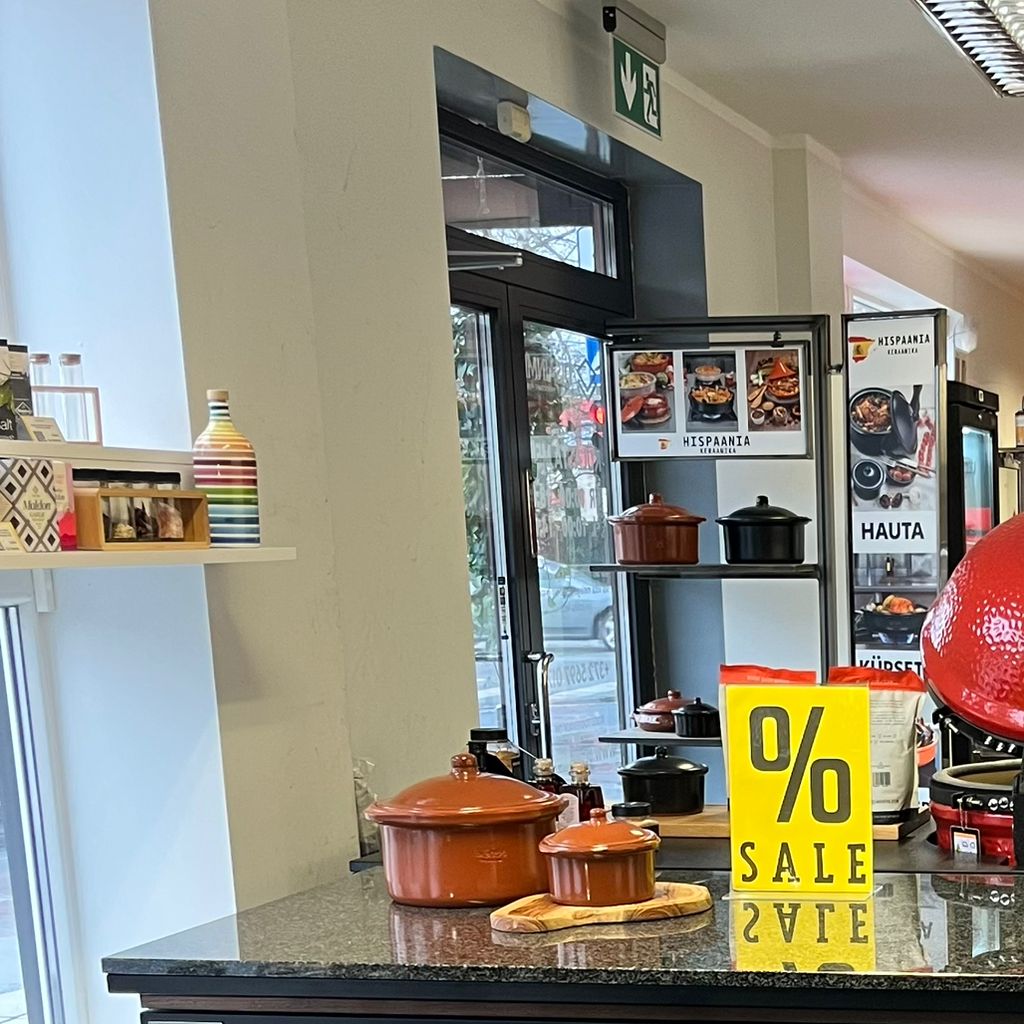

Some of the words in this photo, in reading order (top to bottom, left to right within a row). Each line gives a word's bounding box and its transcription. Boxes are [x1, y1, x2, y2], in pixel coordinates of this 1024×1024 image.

[878, 334, 930, 346] HISPAANIA
[683, 435, 751, 447] HISPAANIA
[861, 522, 925, 540] HAUTA
[740, 842, 866, 884] SALE
